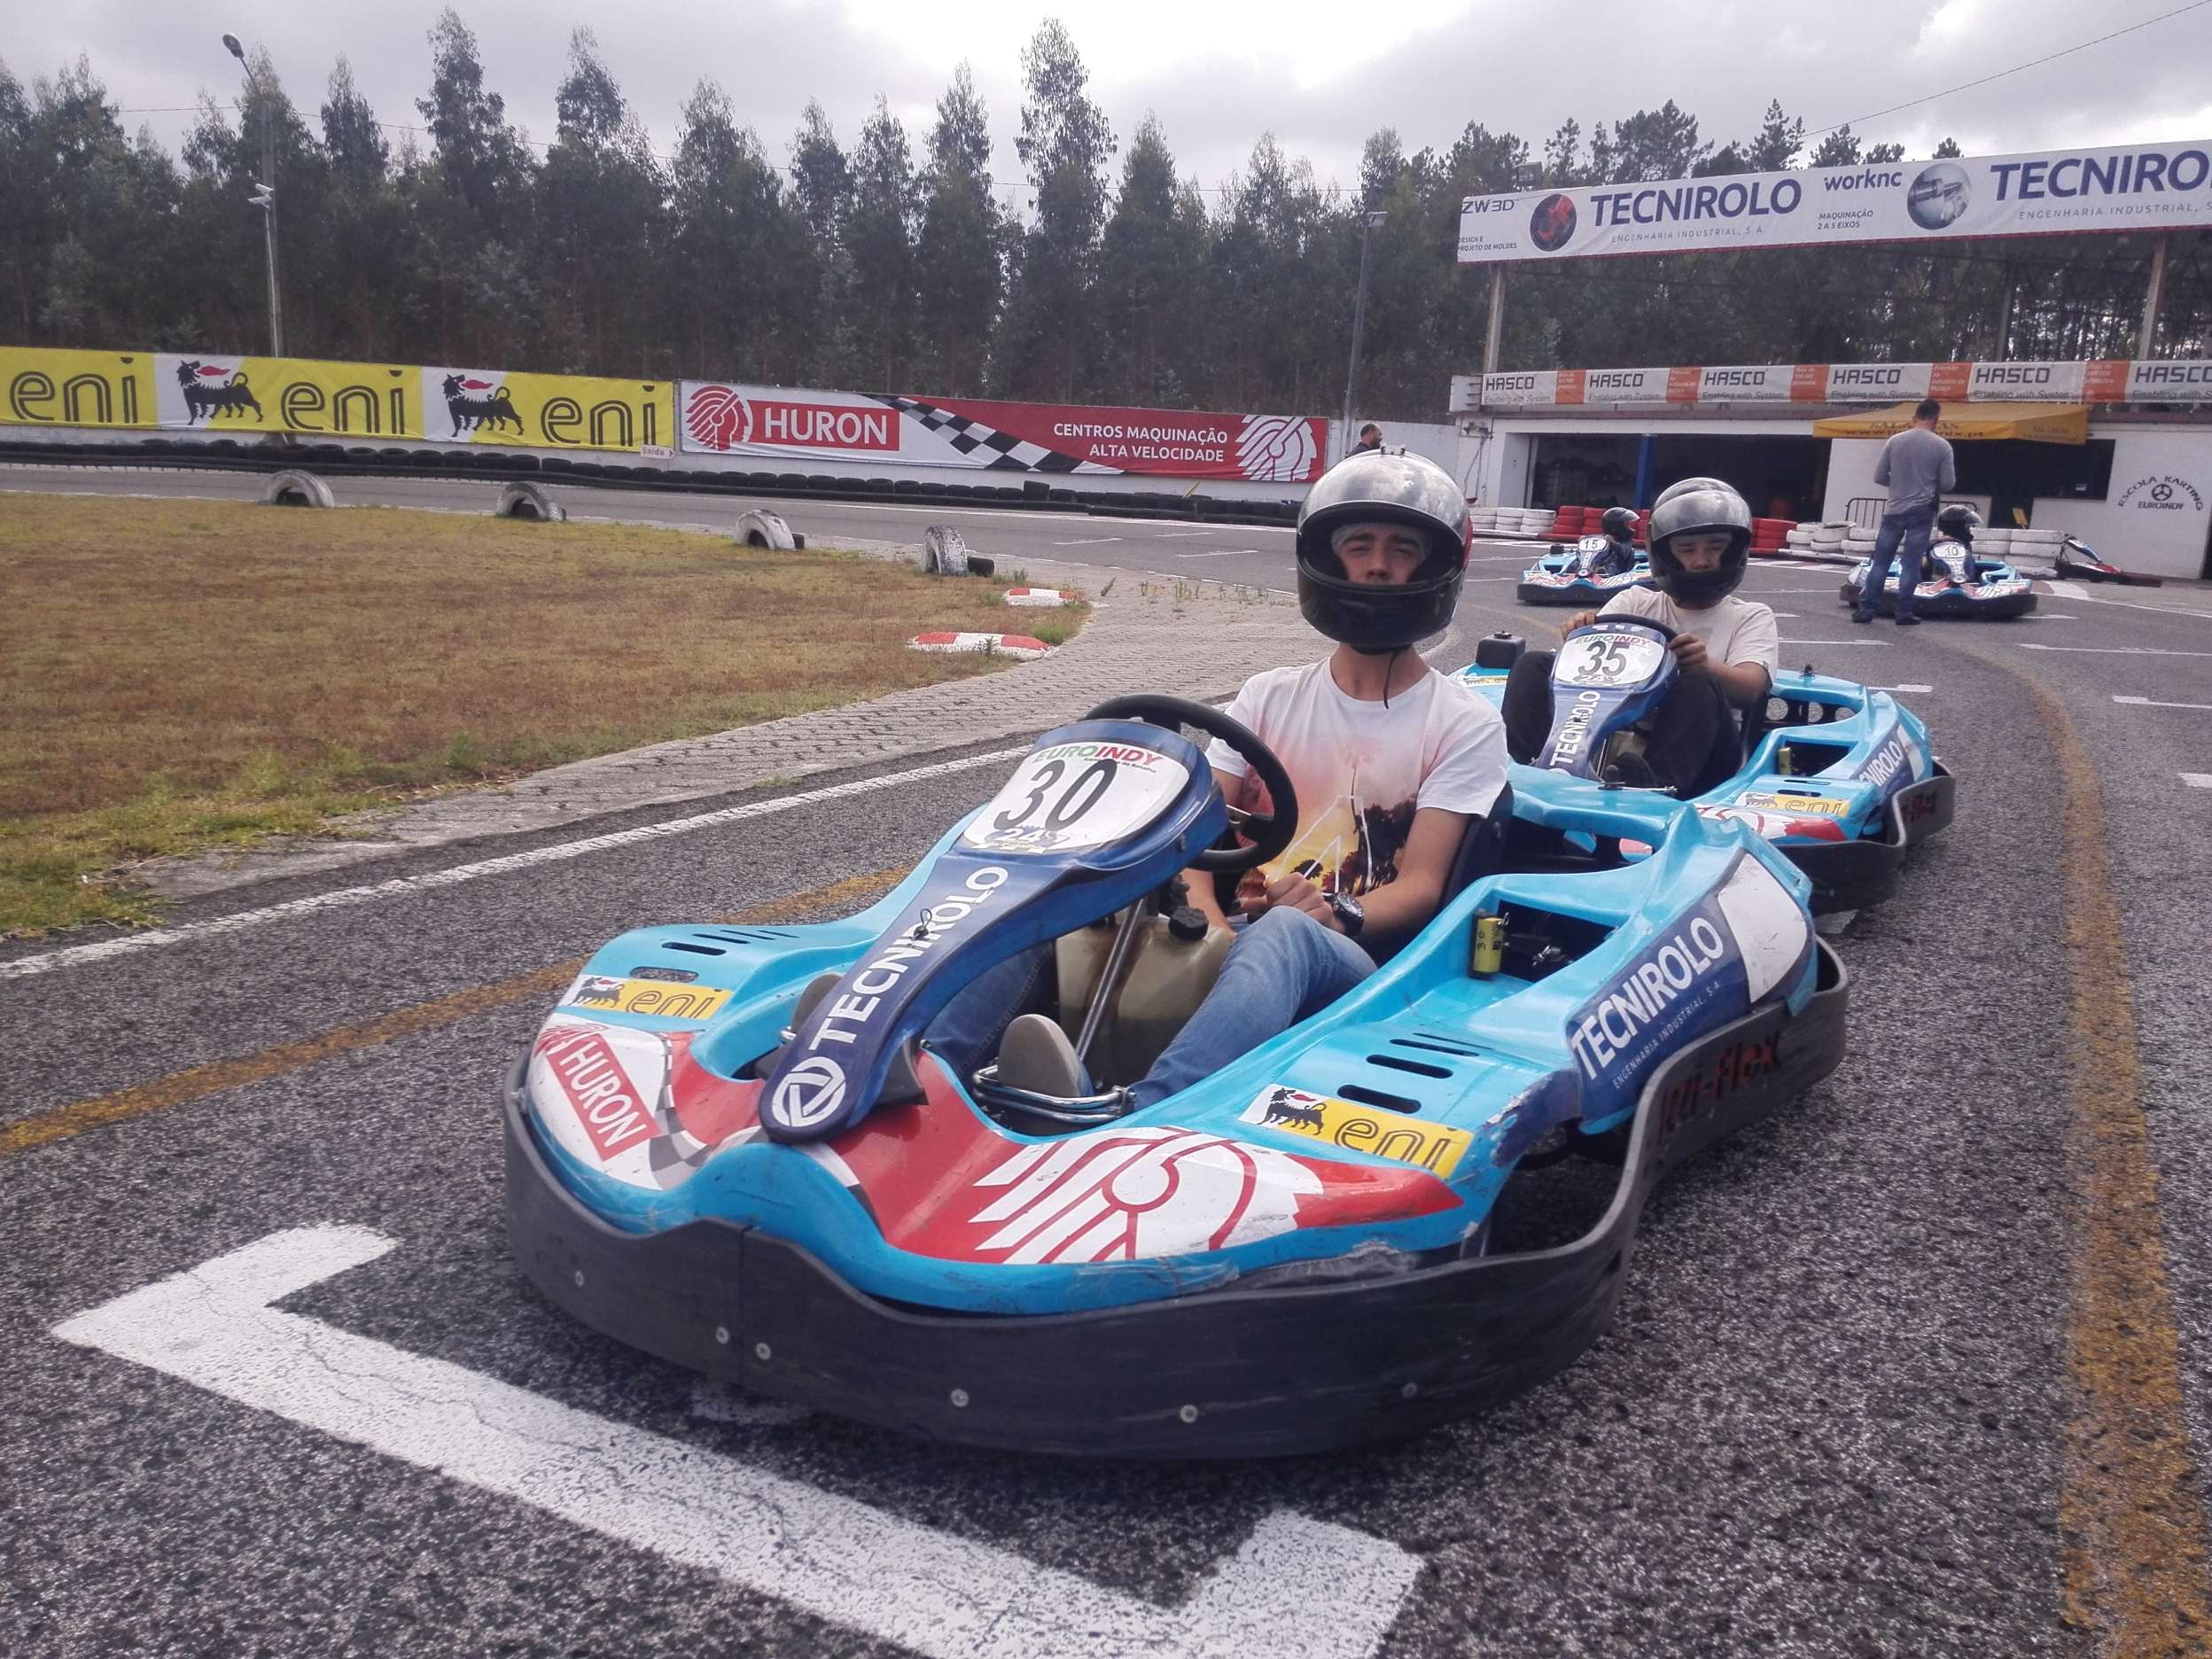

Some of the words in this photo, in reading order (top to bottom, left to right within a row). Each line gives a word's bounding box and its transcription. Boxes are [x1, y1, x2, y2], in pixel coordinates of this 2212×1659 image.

[1824, 168, 1903, 191] worknc
[1990, 149, 2212, 201] TECNIRO
[1461, 199, 1515, 214] ZW3D
[1590, 178, 1803, 227] TECNIROLO
[2020, 207, 2104, 221] ENGENHARIA
[1819, 208, 1874, 221] MAQUINAÇÃO
[1837, 220, 1861, 229] EIXOS
[1611, 231, 1674, 243] ENGENHARIA
[1485, 376, 1535, 391] HASCO
[1589, 373, 1644, 388] HASCO
[1703, 370, 1766, 386] HASCO
[1833, 369, 1901, 385] HASCO
[1975, 367, 2051, 384] HASCO
[10, 356, 138, 424] eni
[280, 369, 406, 435] eni
[540, 384, 658, 448] eni
[764, 406, 888, 445] HURON
[1053, 422, 1124, 440] CENTROS
[1126, 424, 1228, 446] MAQUINAÇÃO
[1089, 443, 1129, 459] ALTA
[1132, 445, 1225, 463] VELOCIDADE
[2117, 476, 2157, 507] ESCOLA
[2164, 476, 2204, 510] KARTING
[2138, 501, 2185, 510] EUROINDY
[1585, 538, 1598, 549] 15
[1944, 546, 1959, 557] 10
[1575, 635, 1652, 645] EUROINDY
[1577, 640, 1631, 677] 35
[1549, 690, 1602, 766] TECNIROLO
[1033, 745, 1164, 767] EUROINDY
[993, 759, 1118, 831] 30
[1784, 798, 1844, 814] eni
[808, 866, 1009, 1050] TECNIROLO
[625, 988, 721, 1019] eni
[1569, 916, 1724, 1080] TECNIROLO
[1613, 1038, 1660, 1090] ENGENHARIA
[559, 1040, 648, 1149] HURON
[1334, 1118, 1458, 1171] eni
